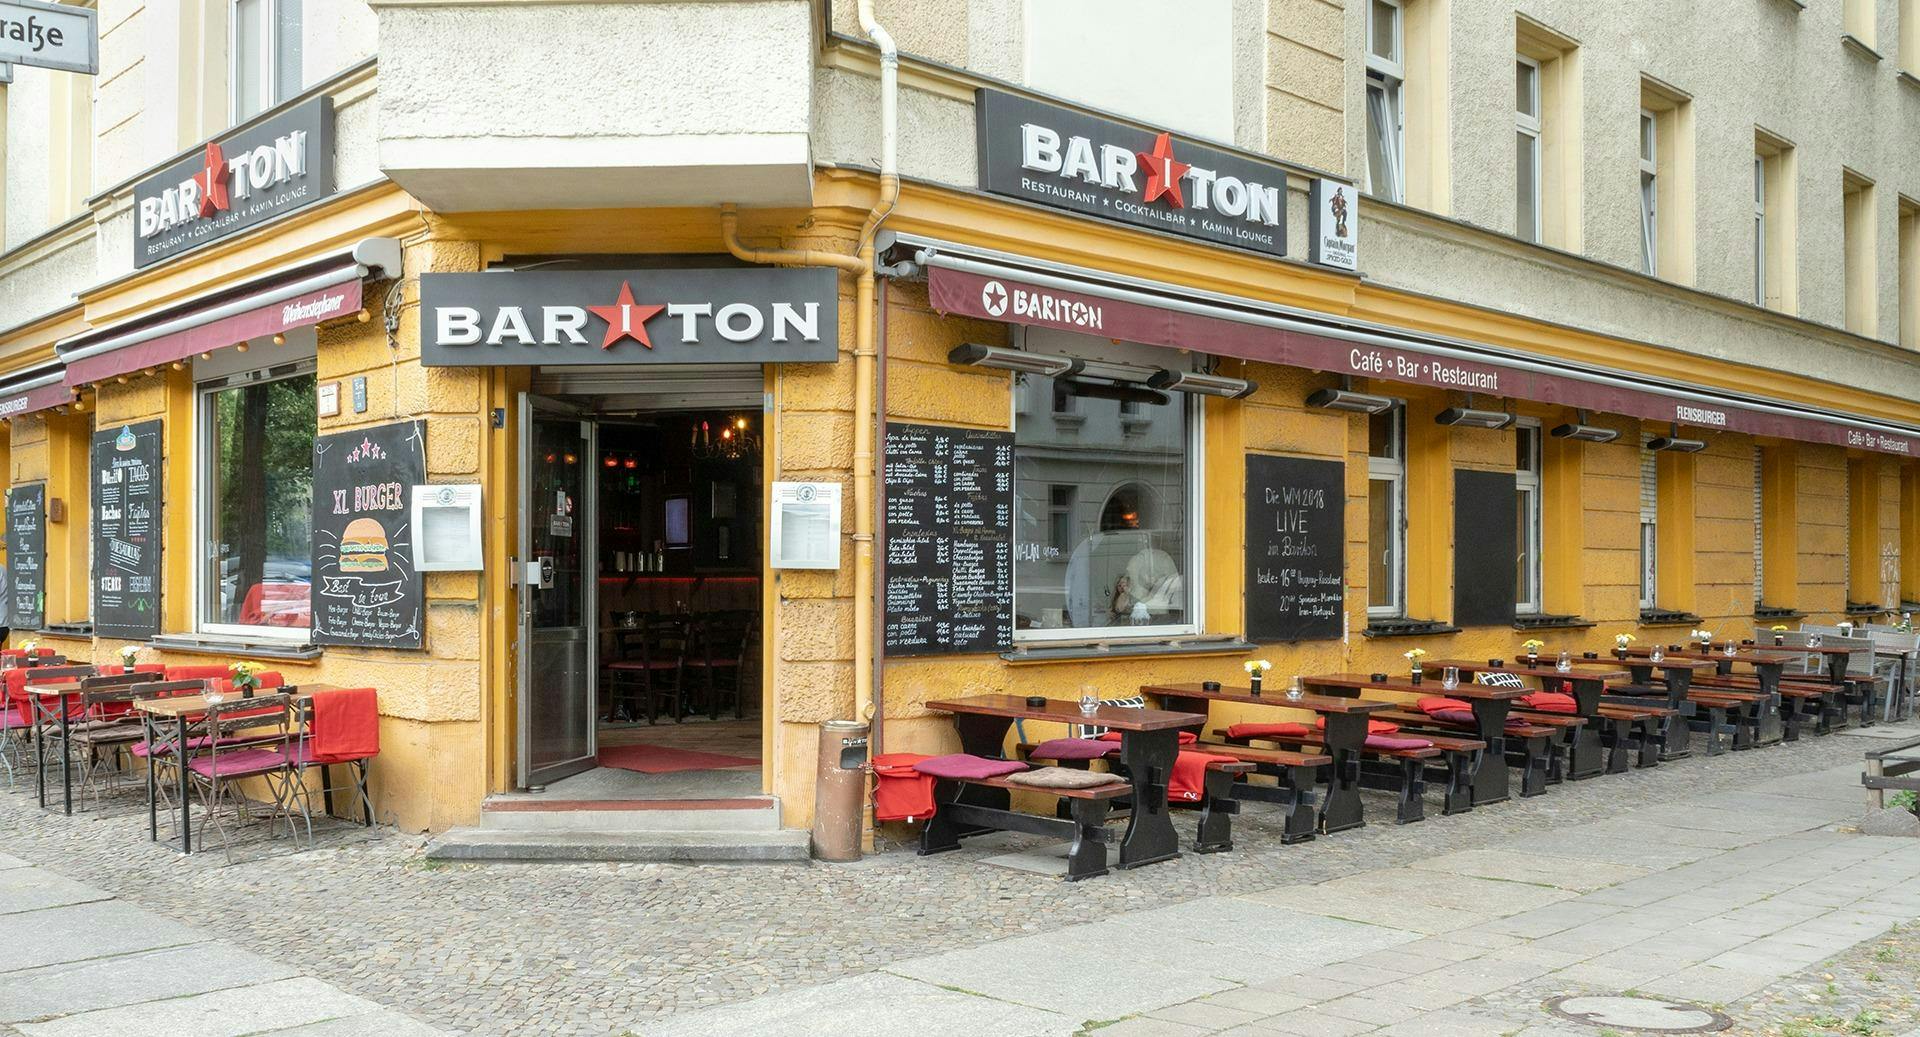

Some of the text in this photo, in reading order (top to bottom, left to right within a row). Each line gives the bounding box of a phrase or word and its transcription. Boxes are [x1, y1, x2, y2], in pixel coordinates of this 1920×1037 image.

[139, 129, 307, 238] BARITON
[1020, 123, 1280, 226] BARITON
[147, 185, 308, 255] RESTAURANT COCKTAILBAR KAMIN LOUNGE
[1021, 176, 1273, 245] RESTAURANT COCKTAILBAR KAMIN LOUNGE
[435, 301, 821, 345] BARITON
[1013, 289, 1103, 330] BARITON
[1350, 348, 1498, 391] Café Bar Restaurant
[1677, 405, 1726, 426] FLENSBURGER
[1847, 430, 1910, 452] Café Bar Restaurant
[333, 489, 350, 515] XL
[354, 481, 403, 513] BURGER
[1265, 486, 1325, 509] Die WM 2018
[1277, 509, 1309, 534] LIVE
[330, 579, 351, 593] Best
[370, 587, 389, 604] town
